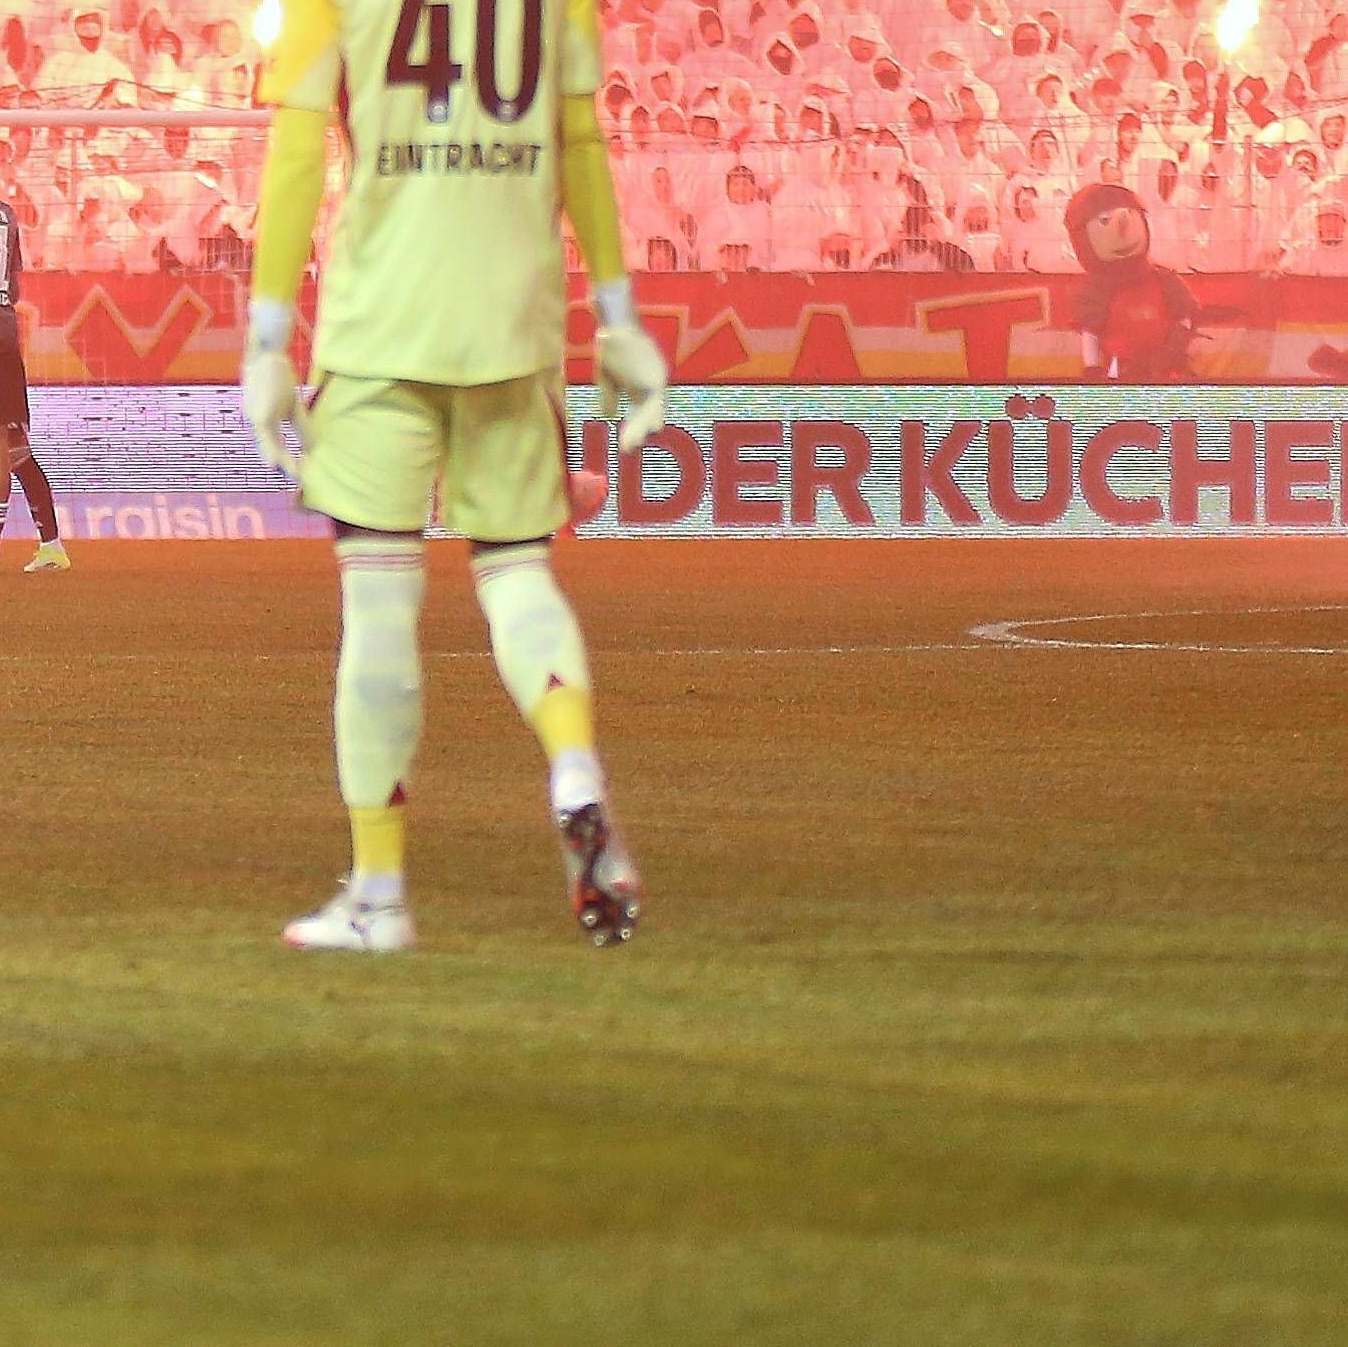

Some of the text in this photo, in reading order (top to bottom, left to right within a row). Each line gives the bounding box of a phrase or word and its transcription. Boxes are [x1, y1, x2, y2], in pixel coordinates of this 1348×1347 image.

[378, 143, 541, 176] EINTRACHT
[900, 394, 1348, 527] KÜCHE
[87, 494, 267, 540] raisin
